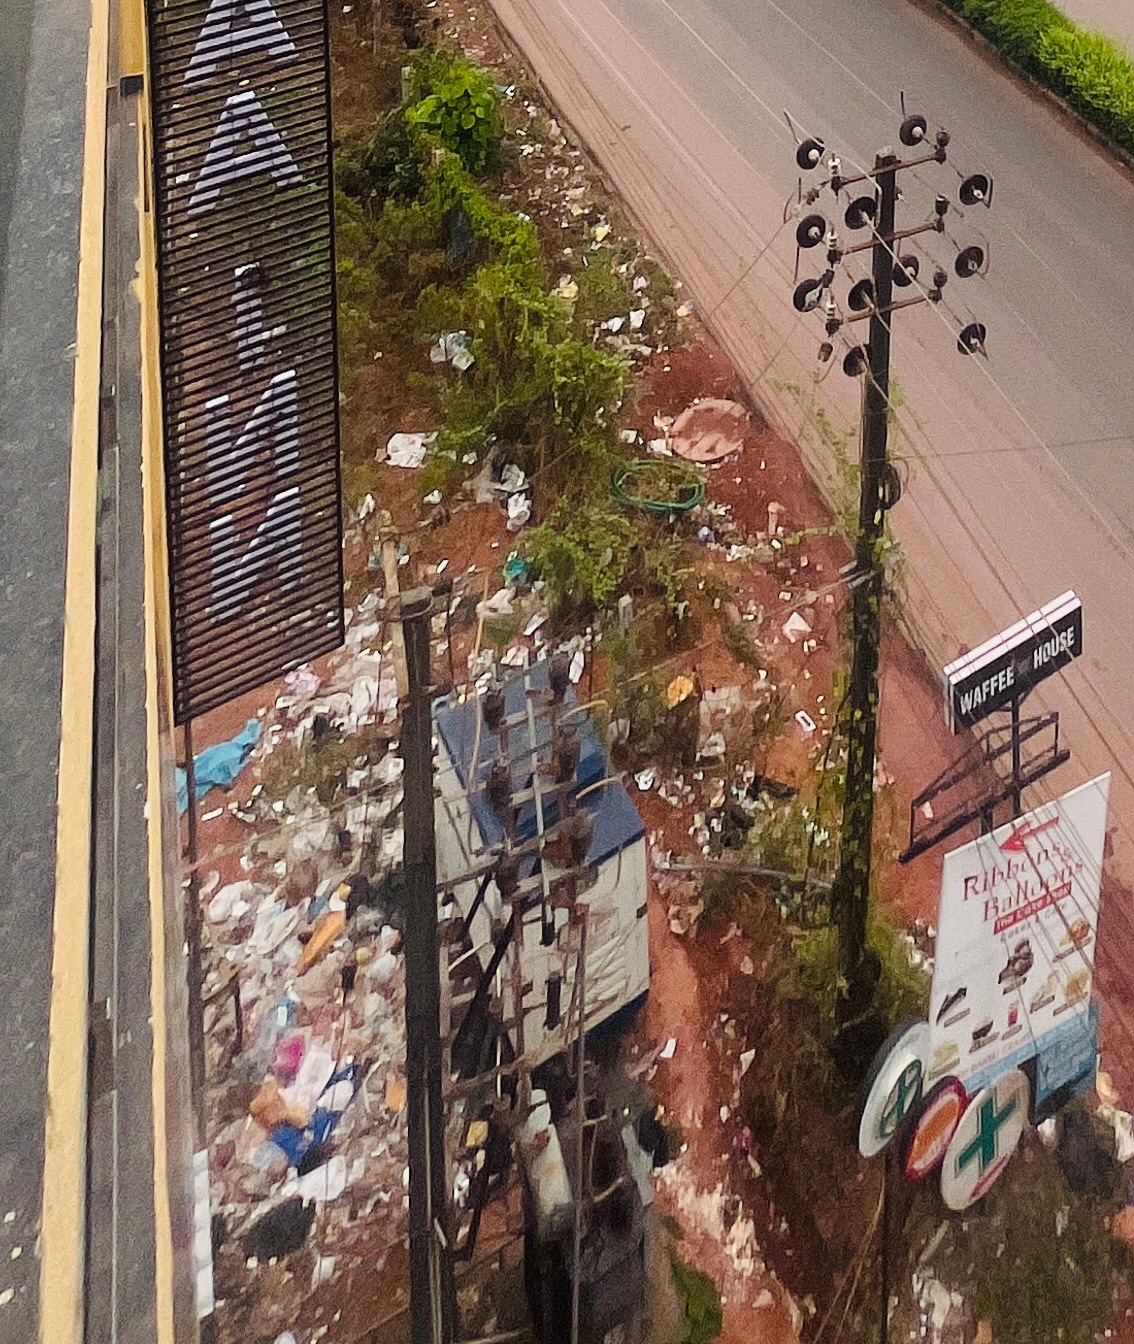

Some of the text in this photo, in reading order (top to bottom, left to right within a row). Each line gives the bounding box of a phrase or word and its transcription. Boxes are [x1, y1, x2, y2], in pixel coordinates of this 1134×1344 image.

[959, 626, 1075, 715] WAFFEE HOUSE
[963, 844, 1061, 901] Ribbons
[983, 862, 1083, 922] Balloons
